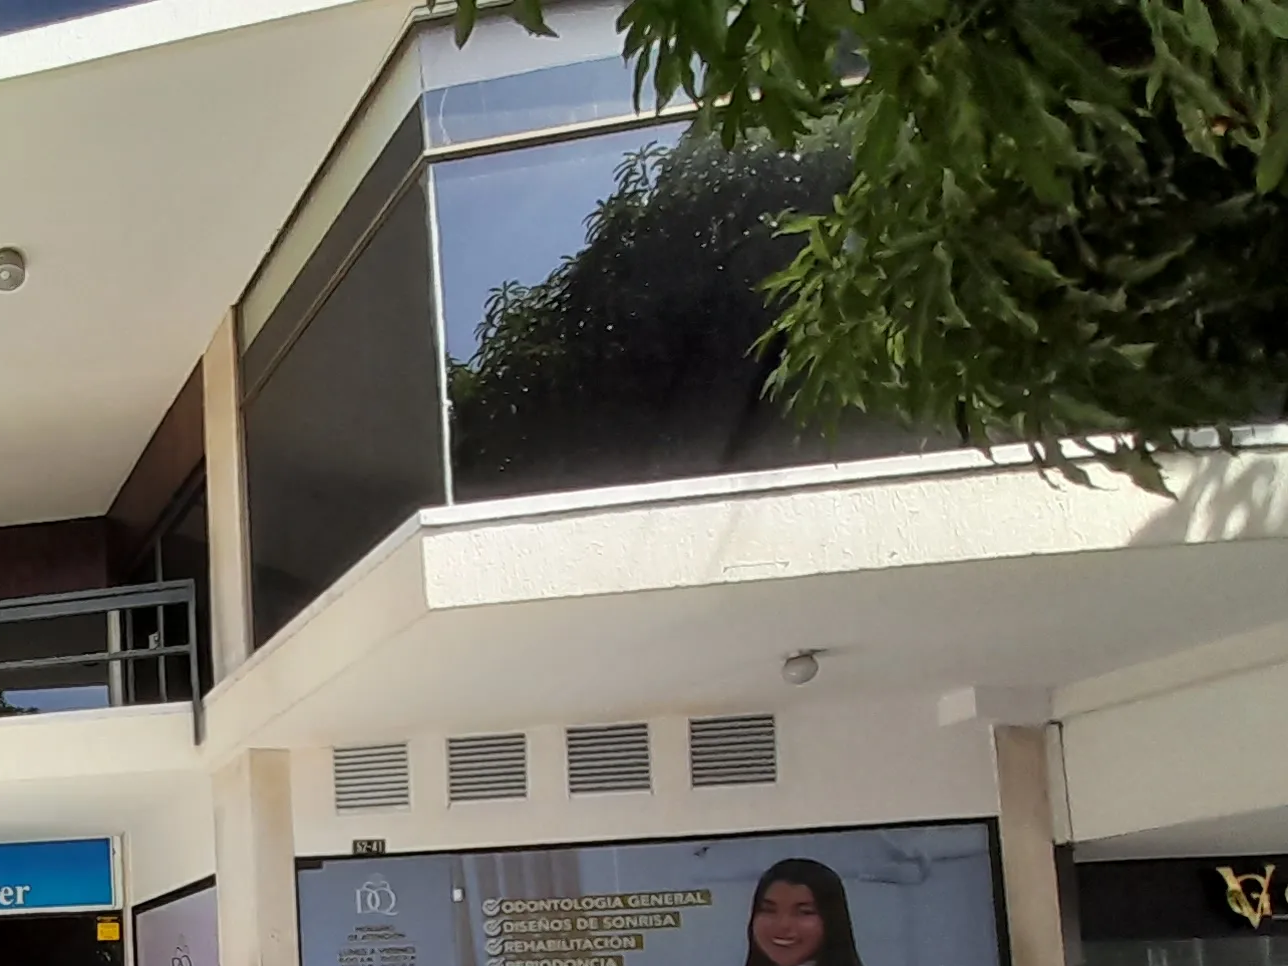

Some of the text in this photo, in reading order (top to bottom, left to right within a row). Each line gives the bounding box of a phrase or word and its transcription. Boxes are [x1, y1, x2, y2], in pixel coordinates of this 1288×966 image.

[628, 892, 705, 908] GENERAL
[576, 917, 599, 931] DE
[602, 914, 676, 930] SONRISA
